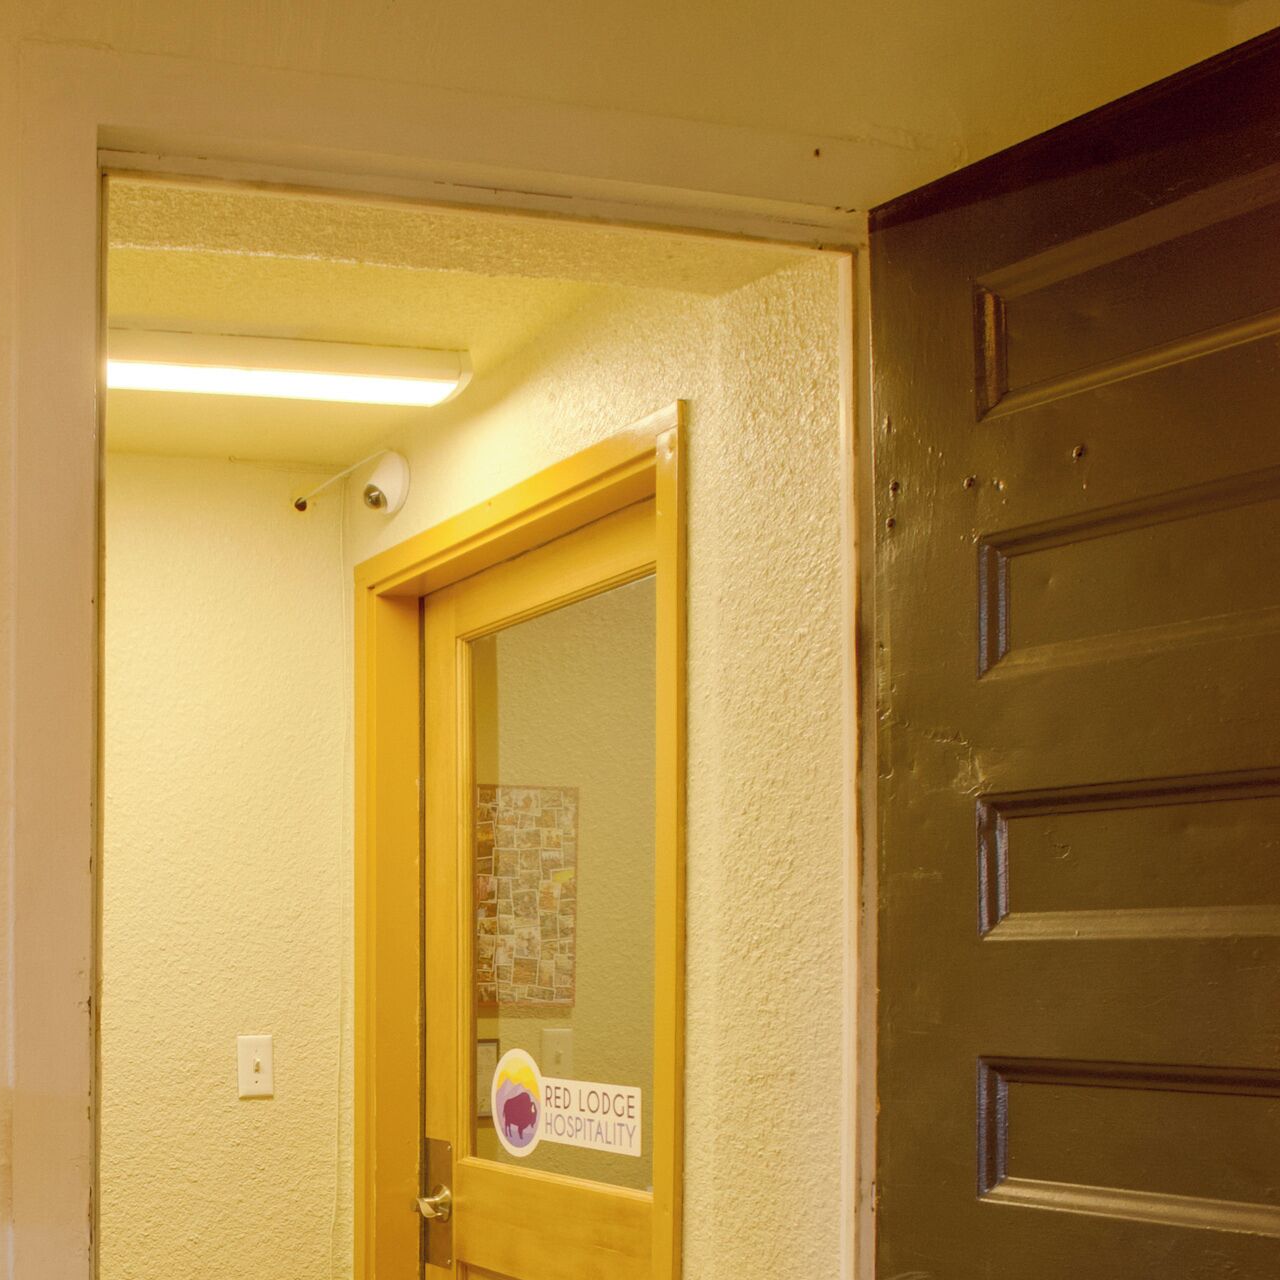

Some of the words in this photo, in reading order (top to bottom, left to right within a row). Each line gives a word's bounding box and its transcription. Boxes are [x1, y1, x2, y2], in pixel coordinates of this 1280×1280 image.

[545, 1085, 571, 1109] RED
[579, 1089, 635, 1119] LODGE
[545, 1112, 636, 1148] HOSPITALITY
